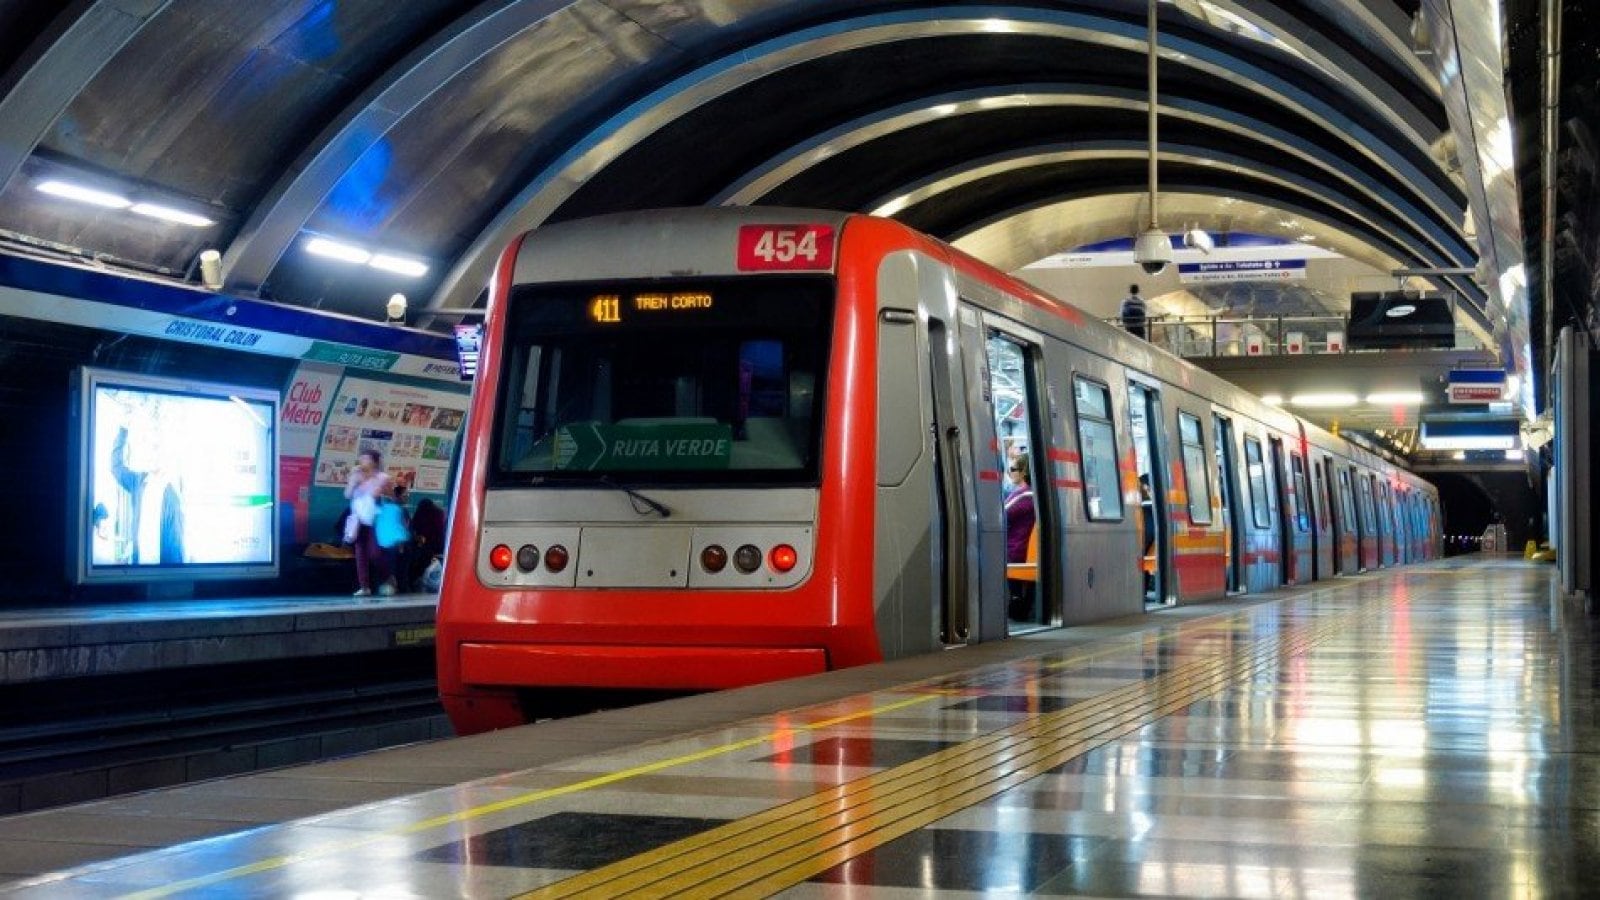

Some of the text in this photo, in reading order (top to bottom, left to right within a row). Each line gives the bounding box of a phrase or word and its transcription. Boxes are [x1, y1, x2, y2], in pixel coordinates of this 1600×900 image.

[754, 230, 818, 262] 454
[594, 297, 621, 322] 411
[636, 295, 712, 310] TREN CORTO
[165, 319, 226, 341] CRISTOBAL
[290, 381, 322, 404] Club
[281, 402, 323, 425] Metro
[613, 438, 728, 457] RUTA VERDE
